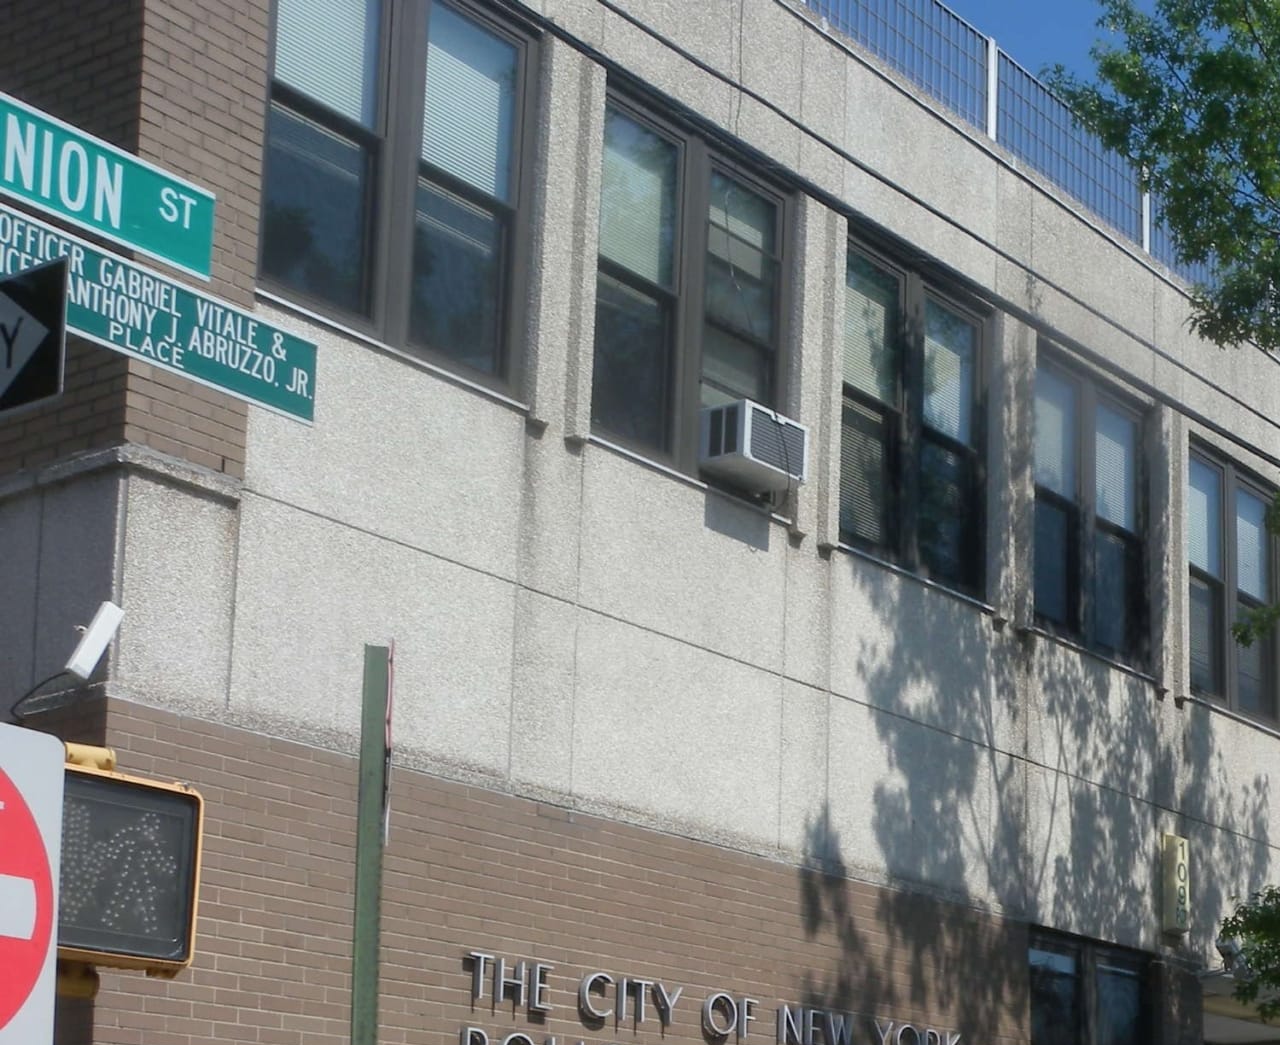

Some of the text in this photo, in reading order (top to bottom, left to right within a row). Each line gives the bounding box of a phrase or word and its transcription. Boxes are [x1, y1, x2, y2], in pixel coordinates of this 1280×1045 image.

[4, 113, 198, 230] NION ST
[66, 271, 157, 334] ANTHONY
[165, 321, 183, 348] J.
[285, 366, 313, 399] JR.
[99, 258, 182, 319] GABRIEL
[196, 298, 258, 349] VITALE
[271, 331, 287, 361] &
[109, 323, 185, 369] PLACE
[469, 951, 554, 1012] THE
[578, 972, 683, 1027] CITY
[703, 993, 759, 1037] OF
